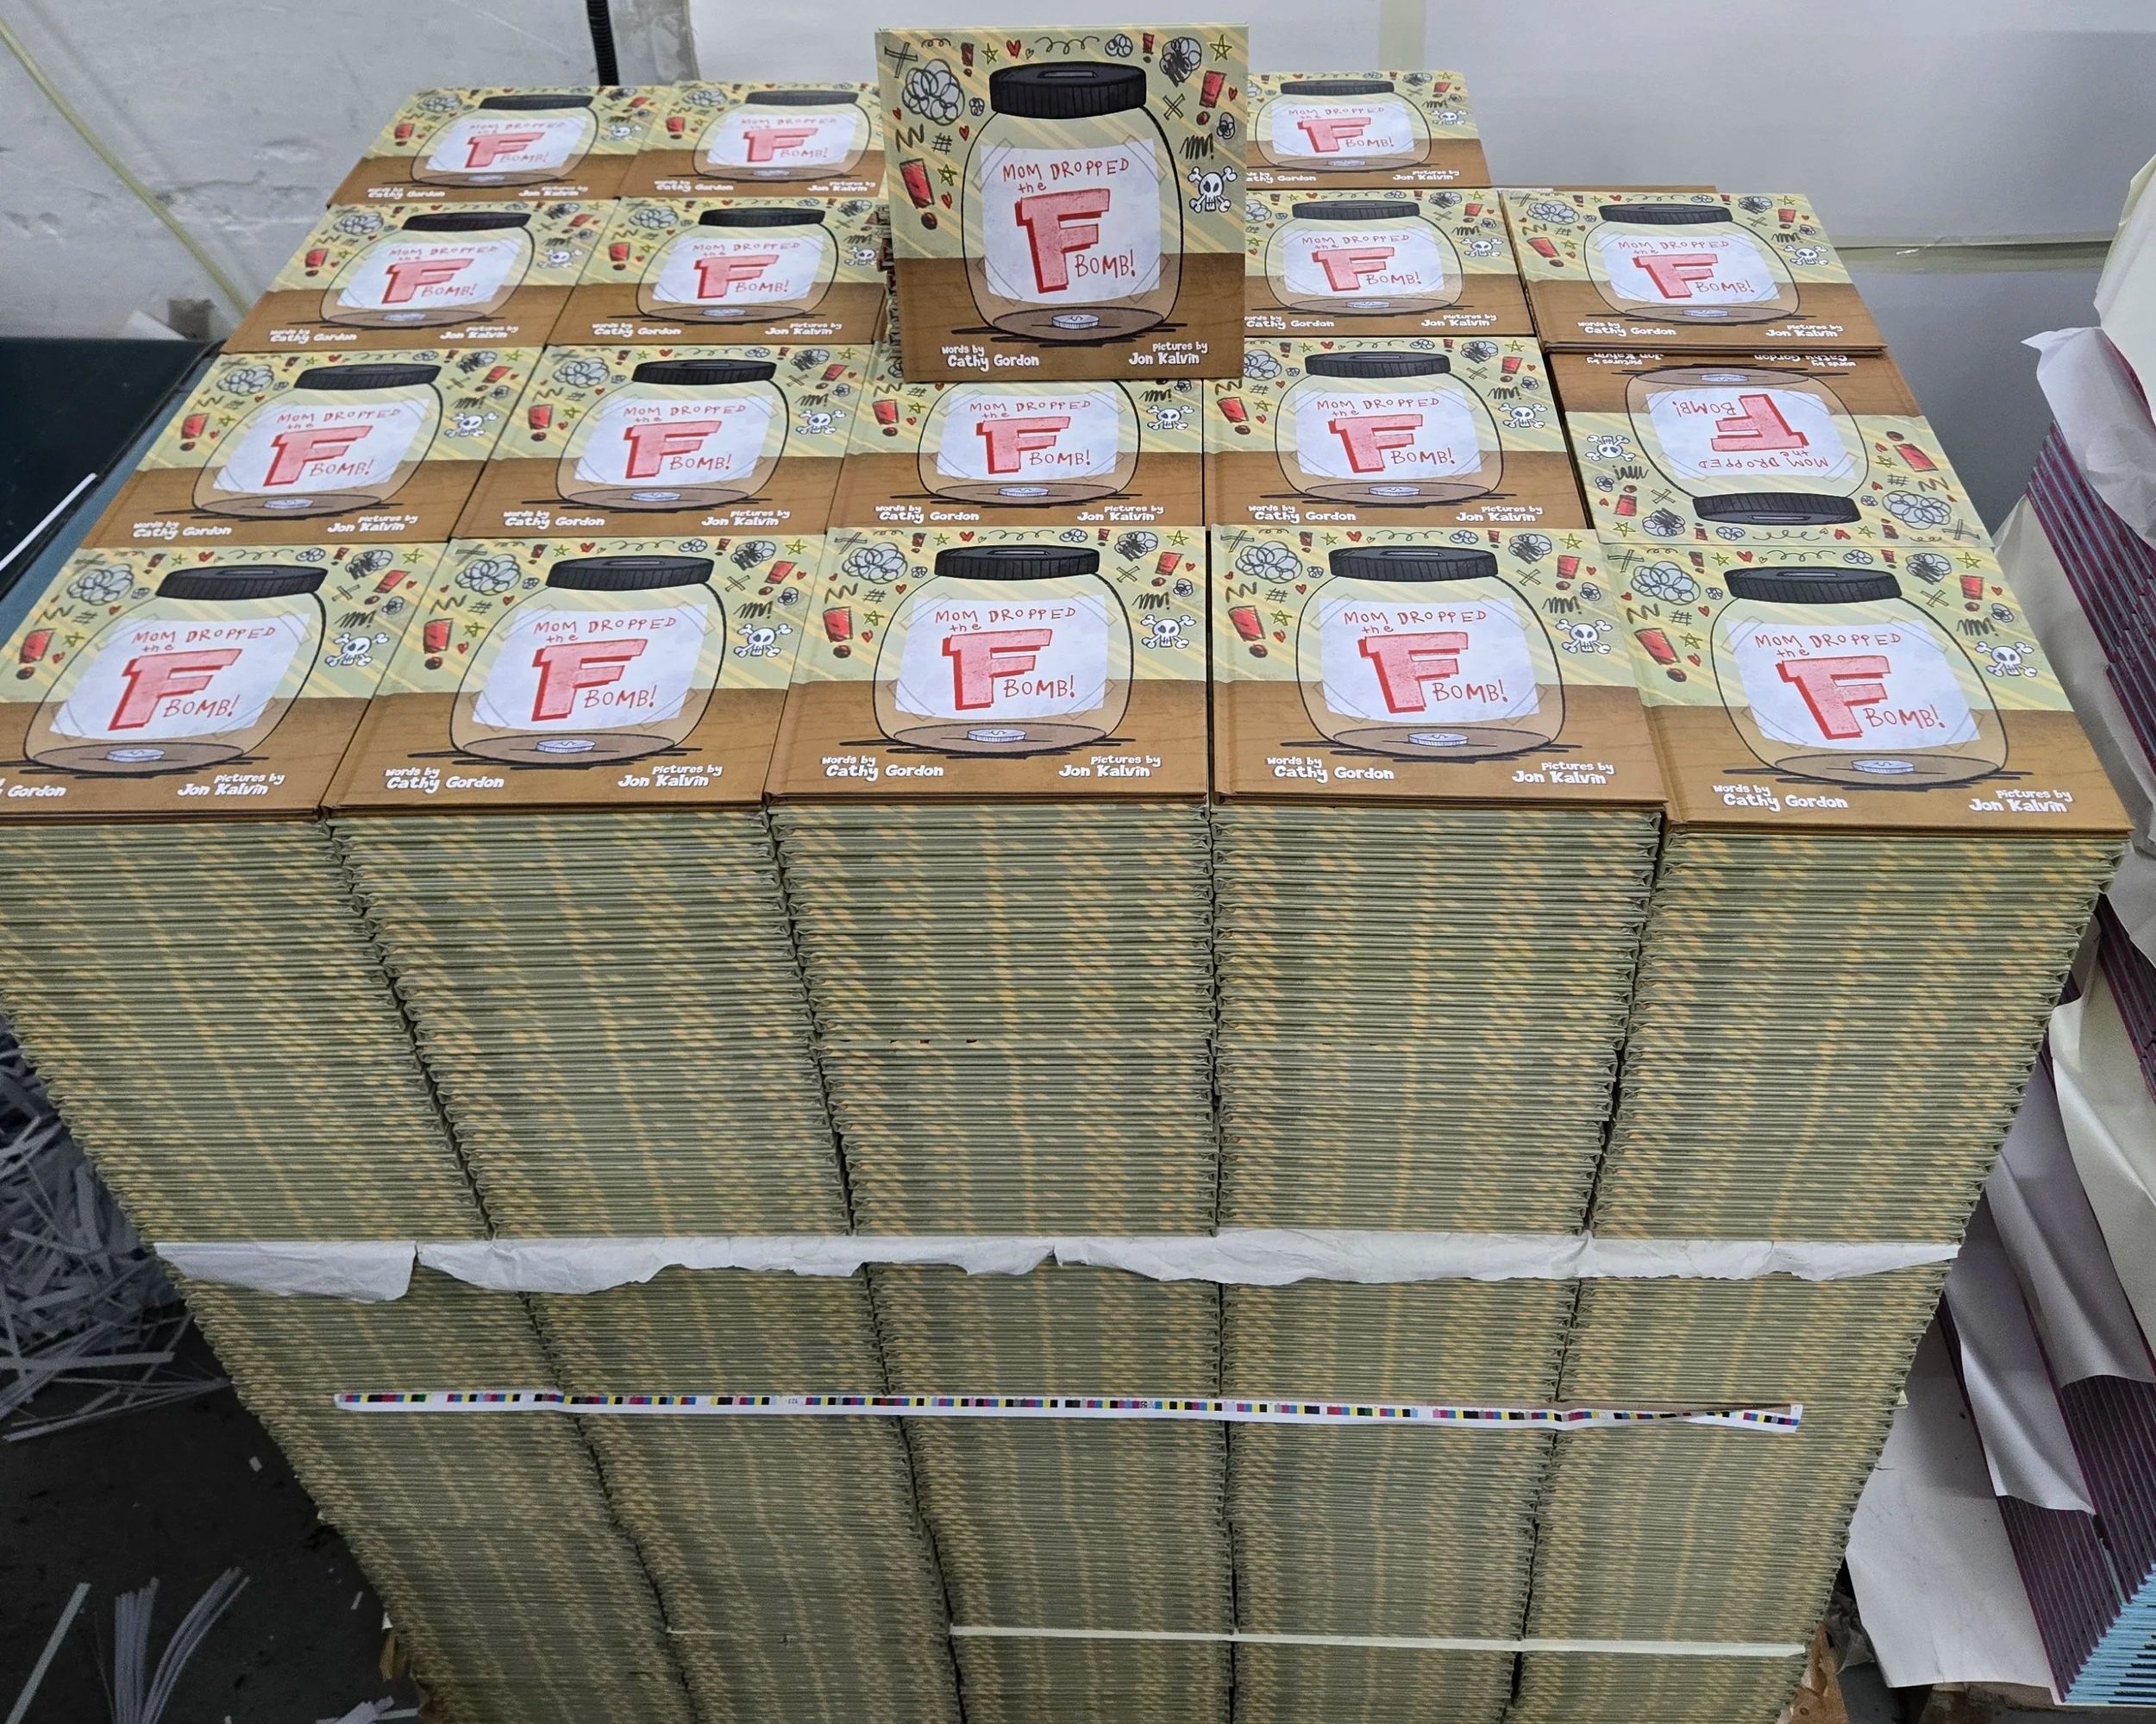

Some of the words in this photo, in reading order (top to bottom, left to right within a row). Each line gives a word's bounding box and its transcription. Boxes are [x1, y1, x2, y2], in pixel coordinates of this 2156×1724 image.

[1295, 116, 1370, 154] F
[464, 131, 546, 168] F
[742, 127, 818, 162] F
[1003, 162, 1042, 181] MOM
[1050, 157, 1129, 179] DROPPED
[1018, 181, 1046, 193] the
[1012, 187, 1109, 293] F
[1075, 248, 1135, 278] BOMB!
[1310, 246, 1395, 292] F
[381, 257, 475, 304] F
[693, 254, 780, 299] F
[1630, 252, 1719, 298] F
[971, 344, 984, 357] by
[1195, 341, 1207, 354] by
[948, 354, 988, 373] Cathy
[993, 354, 1039, 367] Gordon
[1128, 352, 1153, 365] Jon
[1157, 352, 1200, 365] Kalvin
[623, 406, 660, 417] MOM
[669, 404, 745, 416] DROPPED
[969, 401, 1006, 411] MOM
[1015, 399, 1091, 411] DROPPED
[1316, 399, 1355, 410] MOM
[1362, 398, 1439, 409] DROPPED
[1671, 400, 1736, 417] BOMB!
[1709, 393, 1811, 451] F
[623, 419, 723, 479] F
[975, 415, 1071, 474] F
[1326, 413, 1423, 473] F
[262, 424, 374, 487] F
[669, 453, 731, 471] BOMB!
[1029, 448, 1090, 466] BOMB!
[1390, 447, 1455, 465] BOMB!
[1697, 456, 1780, 468] DROPPED
[1785, 456, 1828, 467] MOM
[505, 517, 550, 530] Cathy
[555, 517, 605, 526] Gordon
[701, 517, 729, 525] Jon
[733, 517, 780, 526] Kalvin
[880, 511, 924, 524] Cathy
[929, 511, 980, 520] Gordon
[1076, 511, 1104, 521] Jon
[1109, 511, 1155, 521] Kalvin
[1255, 511, 1300, 524] Cathy
[1305, 511, 1357, 520] Gordon
[1455, 511, 1484, 521] Jon
[1488, 512, 1537, 522] Kalvin
[936, 610, 978, 623] MOM
[988, 607, 1075, 623] DROPPED
[1344, 611, 1388, 624] MOM
[1397, 610, 1486, 624] DROPPED
[534, 620, 576, 634] MOM
[587, 617, 676, 633] DROPPED
[950, 624, 981, 632] the
[1362, 624, 1394, 633] the
[131, 630, 175, 644] MOM
[185, 626, 275, 643] DROPPED
[546, 634, 578, 643] the
[1754, 633, 1802, 647] MOM
[1808, 632, 1902, 647] DROPPED
[142, 643, 173, 653] the
[1777, 648, 1809, 656] the
[942, 629, 1052, 711] F
[1356, 631, 1469, 713] F
[531, 638, 649, 721] F
[1004, 674, 1075, 699] BOMB!
[108, 648, 243, 730] F
[584, 684, 656, 709] BOMB!
[1432, 679, 1507, 703] BOMB!
[1773, 655, 1891, 739] F
[163, 693, 240, 718] BOMB!
[1863, 703, 1944, 729] BOMB!
[860, 755, 876, 767] by
[1145, 755, 1161, 767] by
[1305, 756, 1322, 768] by
[1596, 762, 1614, 774] by
[423, 767, 440, 779] by
[706, 764, 723, 776] by
[826, 765, 879, 781] Cathy
[885, 764, 943, 776] Gordon
[1059, 764, 1090, 777] Jon
[1097, 765, 1150, 777] Kalvin
[1275, 766, 1327, 783] Cathy
[1334, 766, 1395, 780] Gordon
[1512, 770, 1545, 782] Jon
[1549, 771, 1607, 784] Kalvin
[267, 774, 285, 785] by
[386, 776, 440, 793] Cathy
[445, 775, 505, 788] Gordon
[617, 774, 650, 787] Jon
[655, 774, 710, 787] Kalvin
[8, 784, 67, 796] Gordon
[177, 783, 210, 795] Jon
[214, 783, 269, 795] Kalvin
[1752, 784, 1771, 797] by
[2053, 790, 2072, 802] by
[1725, 793, 1781, 812] Cathy
[1786, 794, 1849, 808] Gordon
[1969, 798, 2004, 811] Jon
[2006, 799, 2068, 812] Kalvin
